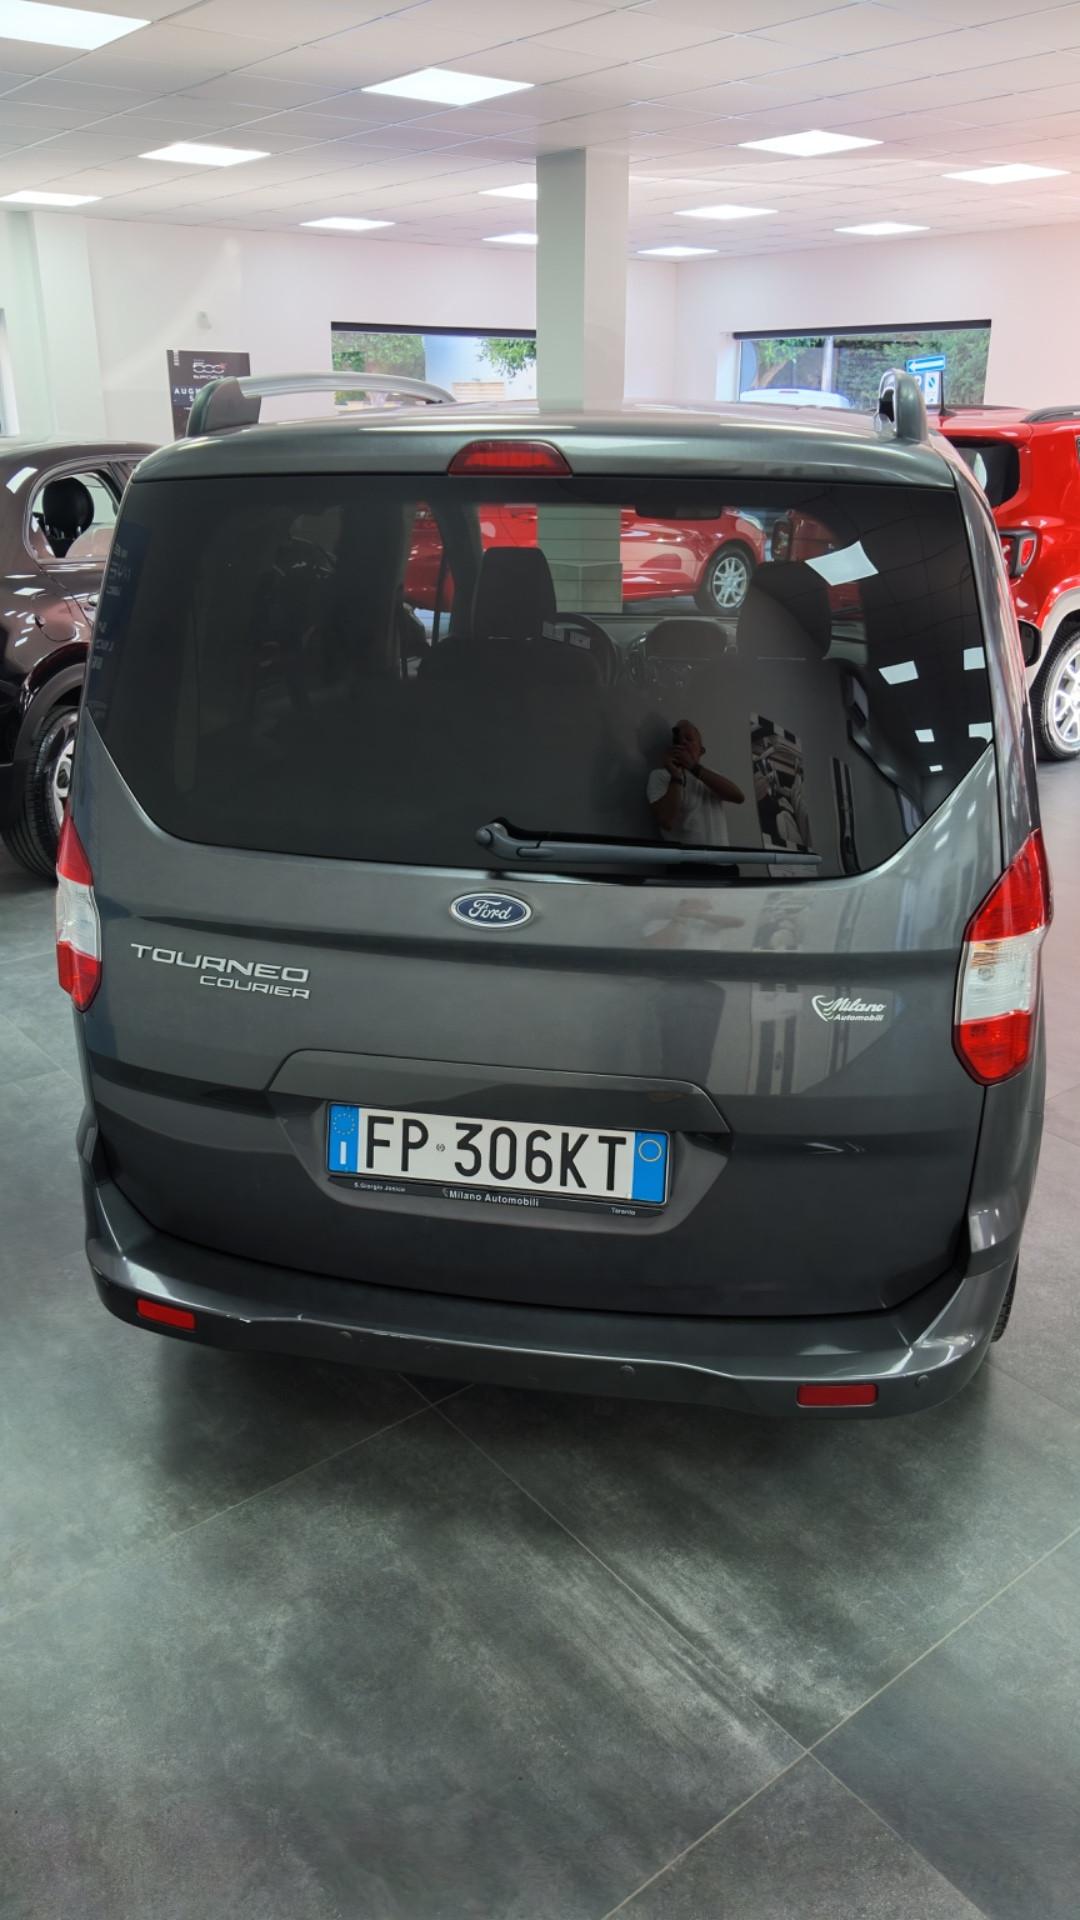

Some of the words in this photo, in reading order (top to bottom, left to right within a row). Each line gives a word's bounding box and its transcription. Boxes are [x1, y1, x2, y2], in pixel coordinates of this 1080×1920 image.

[468, 899, 512, 920] Ford
[130, 943, 309, 983] TOURNEO
[199, 975, 310, 1000] COURIER
[831, 997, 887, 1012] Milano
[366, 1115, 429, 1172] FP
[454, 1122, 627, 1191] 306KT
[449, 1190, 482, 1201] Milano
[484, 1193, 540, 1207] Automobili
